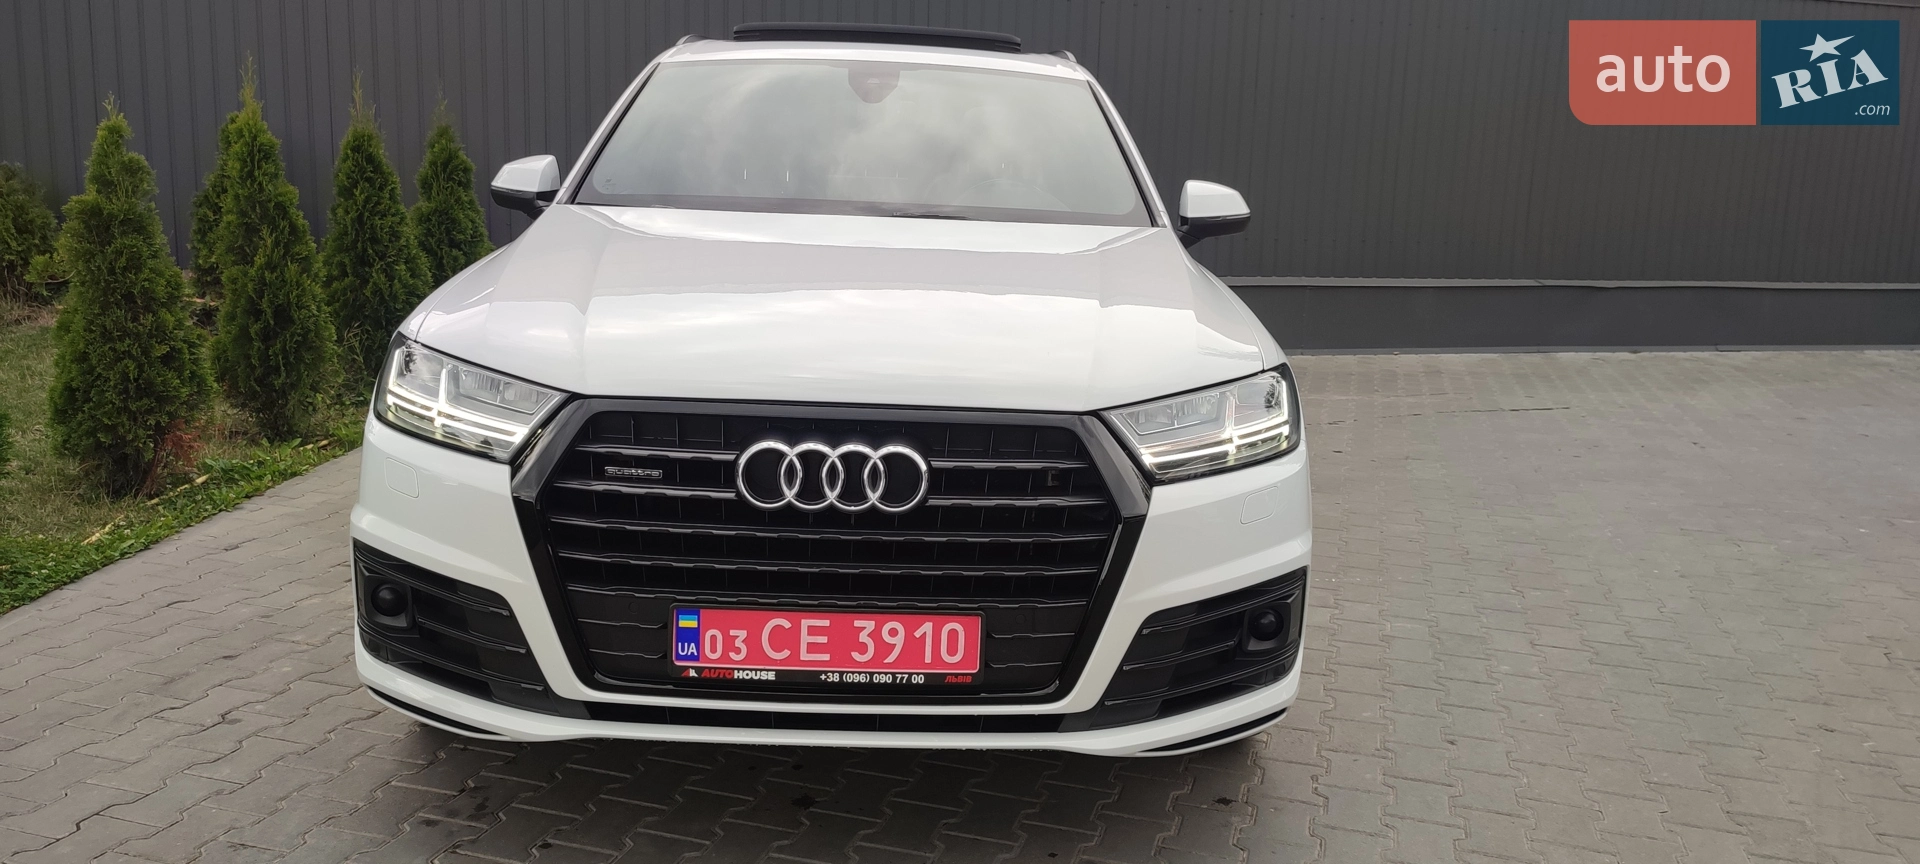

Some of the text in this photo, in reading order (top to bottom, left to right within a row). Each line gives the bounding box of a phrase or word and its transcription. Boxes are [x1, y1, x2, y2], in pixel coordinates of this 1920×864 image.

[704, 618, 965, 664] 03 CE 3910
[678, 642, 698, 656] UA
[701, 668, 776, 680] AUTOHOUSE
[819, 672, 925, 684] +38 (096) 090 77 00
